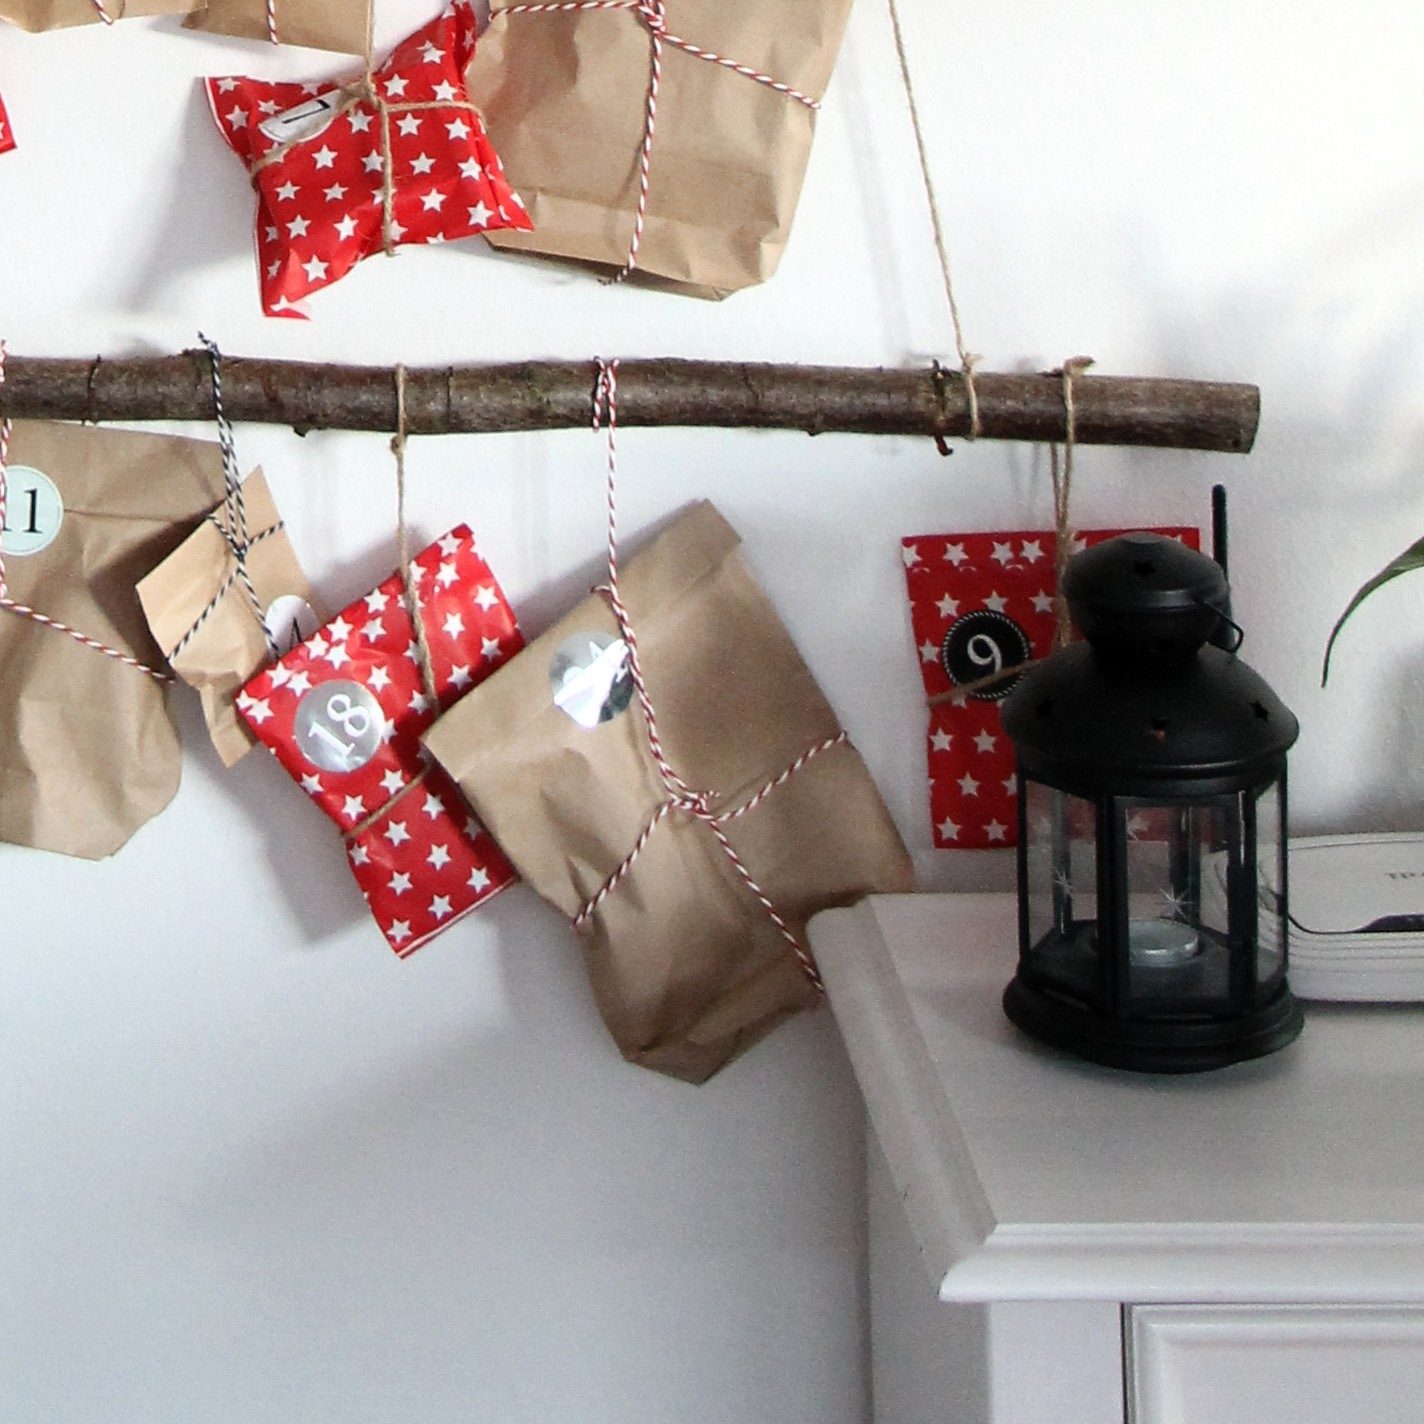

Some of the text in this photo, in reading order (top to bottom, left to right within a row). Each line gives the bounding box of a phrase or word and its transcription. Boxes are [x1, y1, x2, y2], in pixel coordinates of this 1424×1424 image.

[1, 488, 44, 534] 1
[967, 634, 1002, 674] 9
[308, 693, 370, 758] 18
